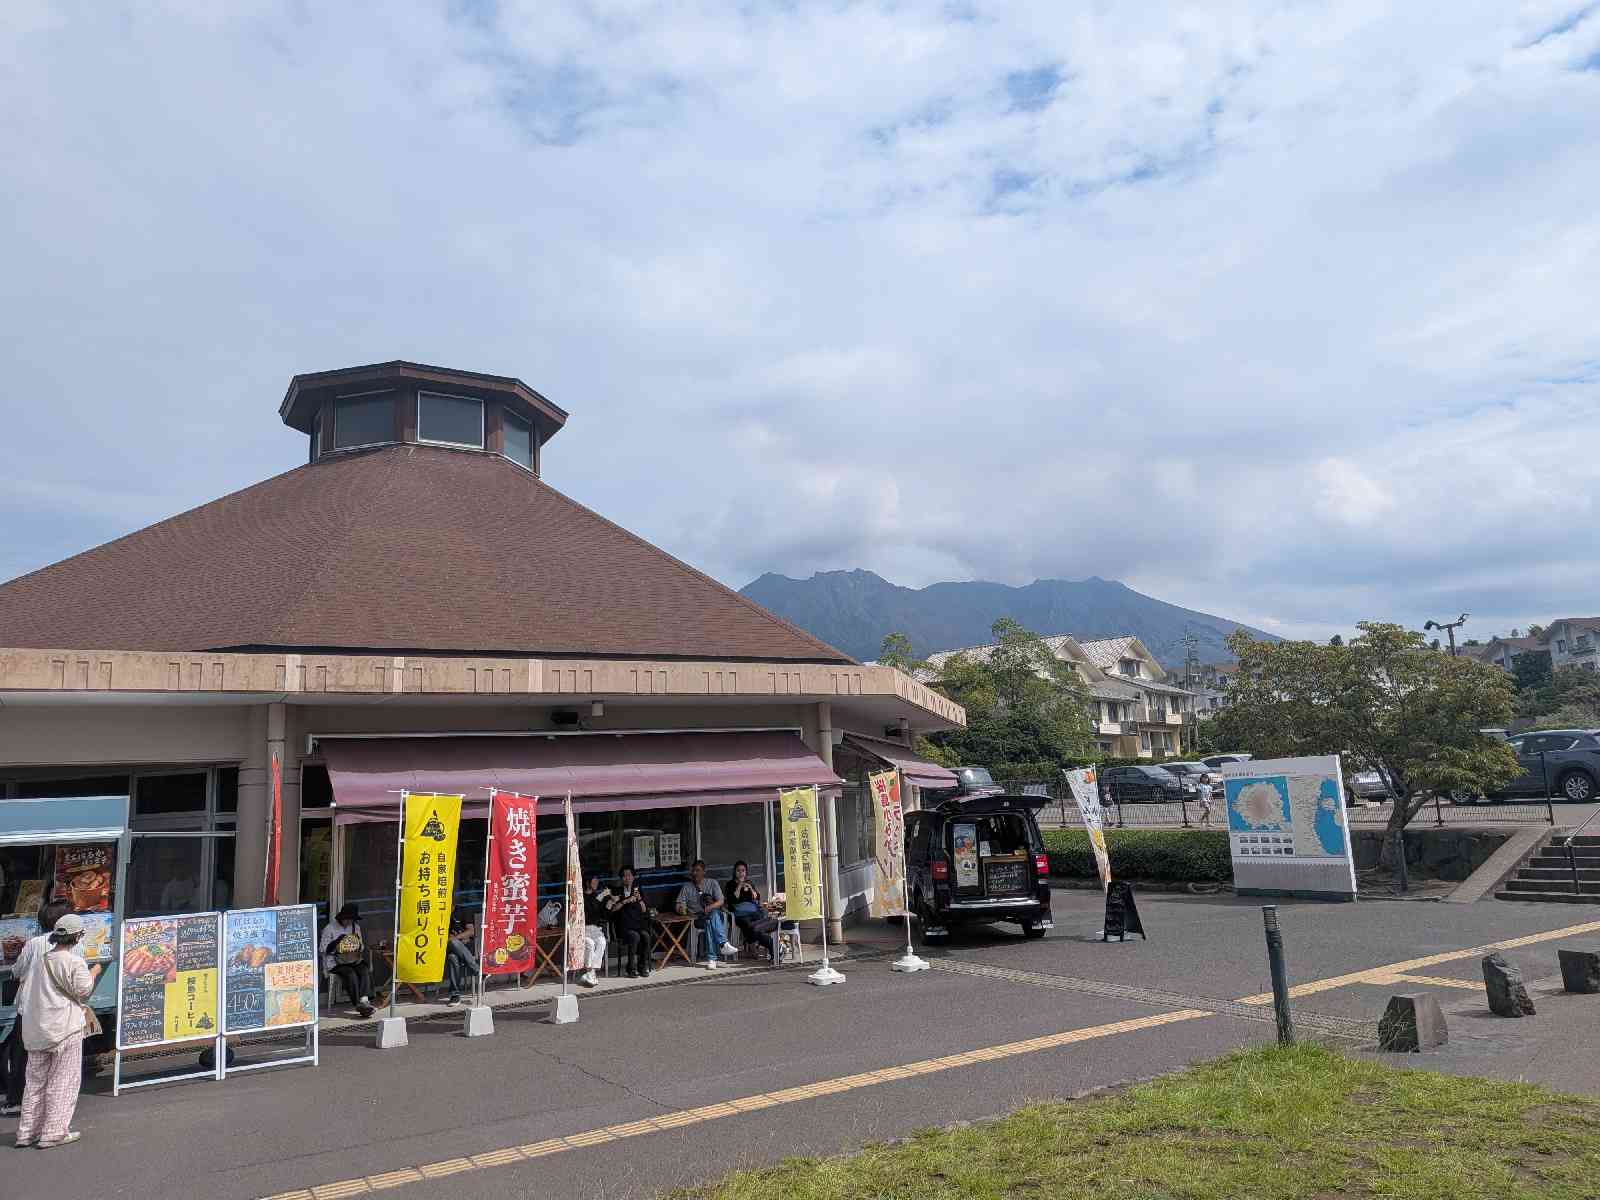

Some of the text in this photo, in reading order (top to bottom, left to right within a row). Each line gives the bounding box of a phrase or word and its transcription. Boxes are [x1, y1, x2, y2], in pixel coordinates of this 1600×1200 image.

[414, 851, 431, 965] お持ち帰りOK
[437, 851, 448, 948] 自家焙煎コーヒー
[496, 807, 531, 934] 焼き蜜芋
